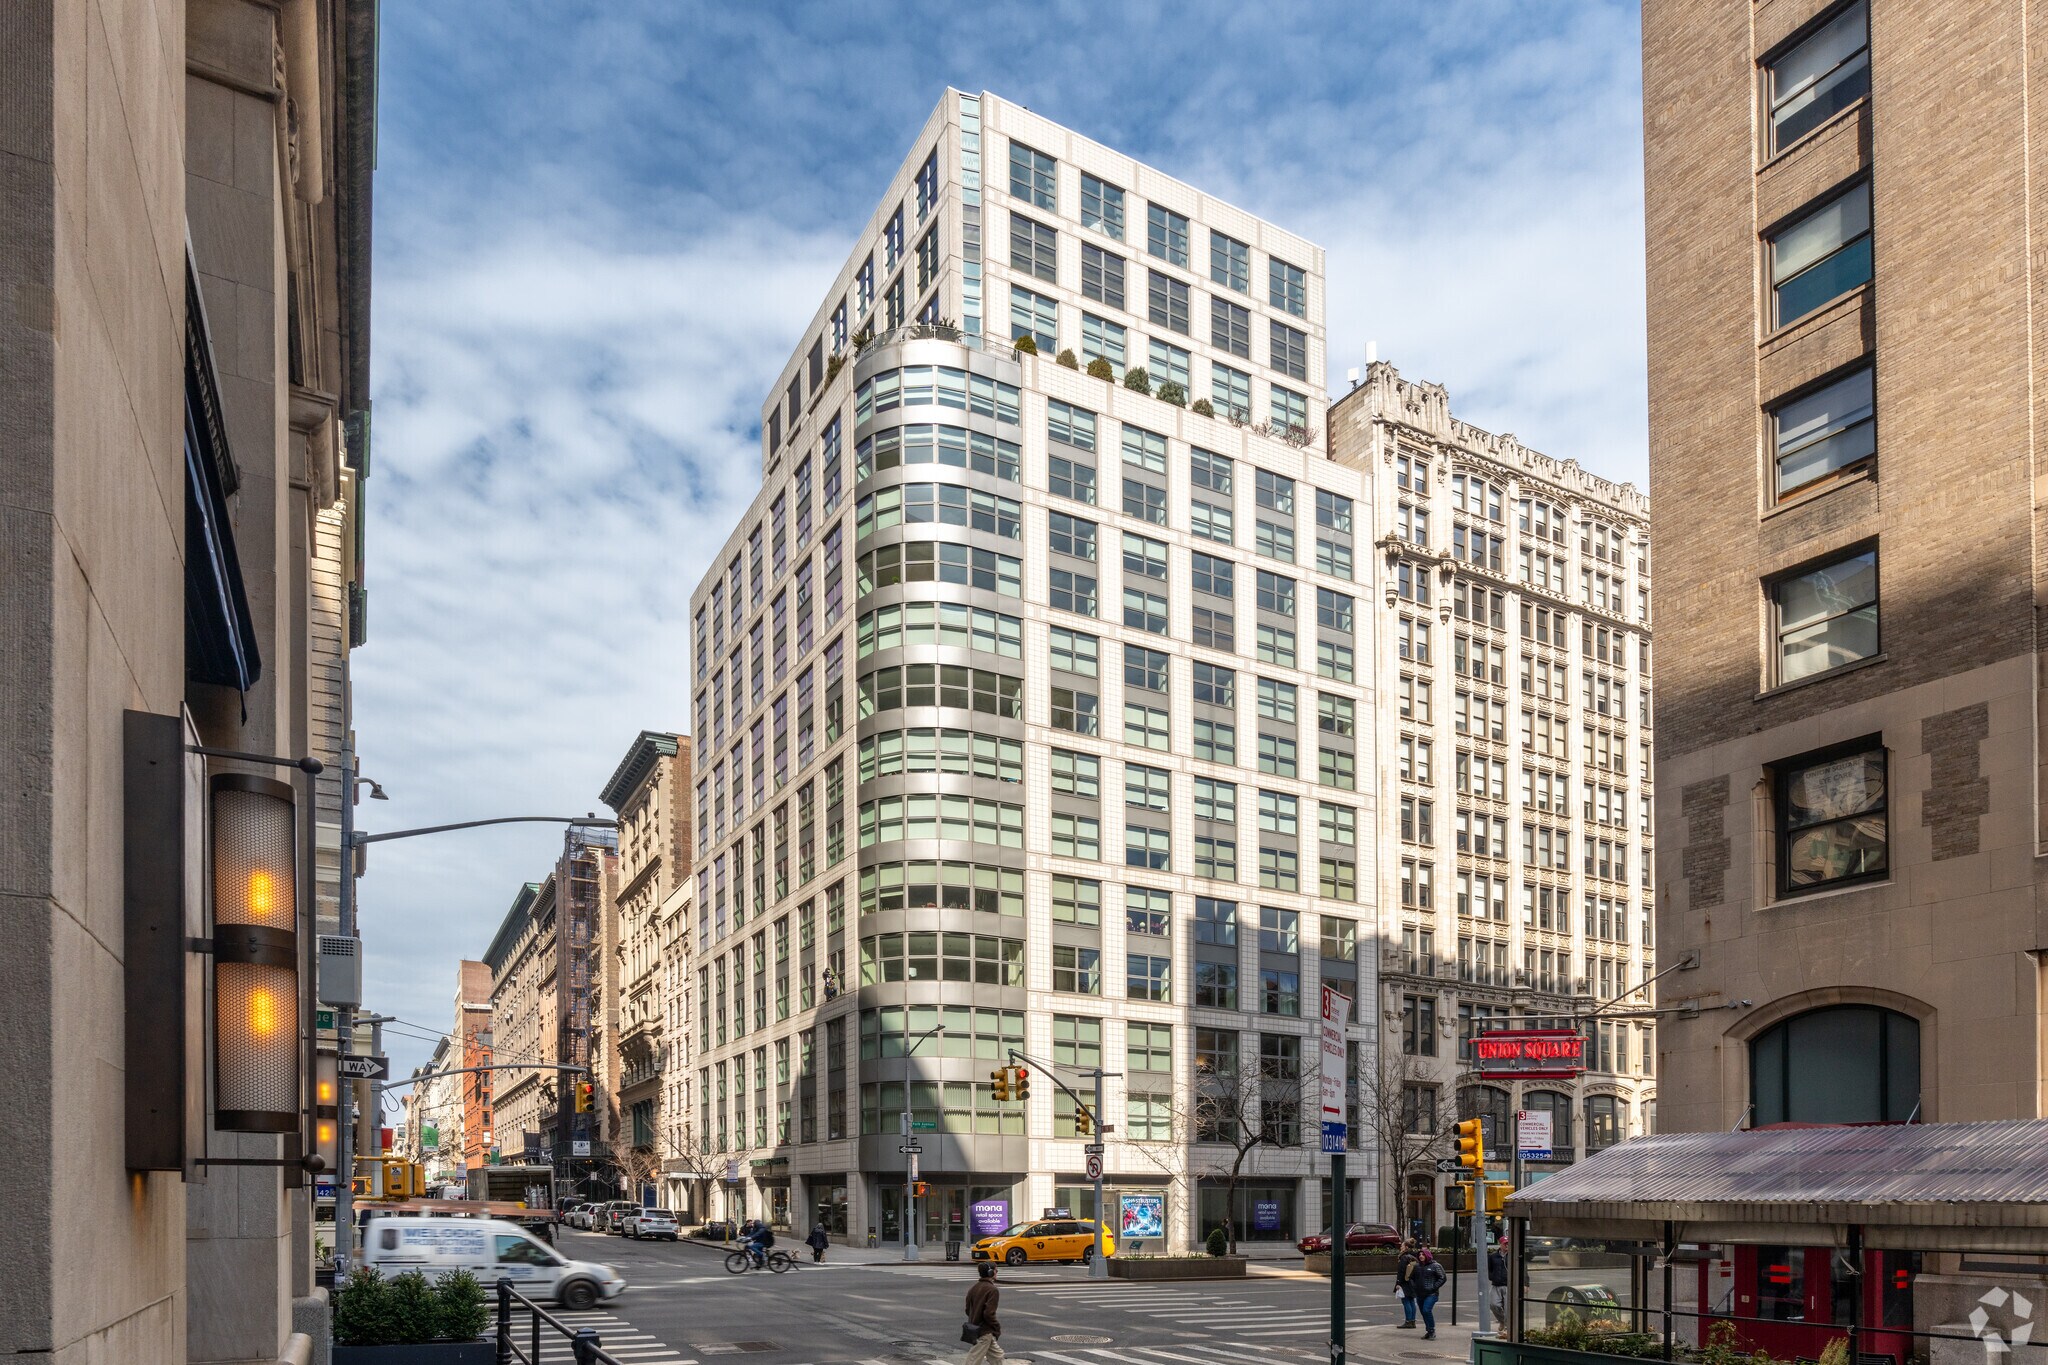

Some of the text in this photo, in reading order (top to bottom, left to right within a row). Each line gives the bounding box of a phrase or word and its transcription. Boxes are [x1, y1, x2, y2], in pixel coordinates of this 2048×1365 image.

[1324, 990, 1330, 1017] 3
[1478, 1041, 1582, 1061] UNION SQUARE
[349, 1062, 375, 1072] WAY
[1520, 1111, 1526, 1120] 3
